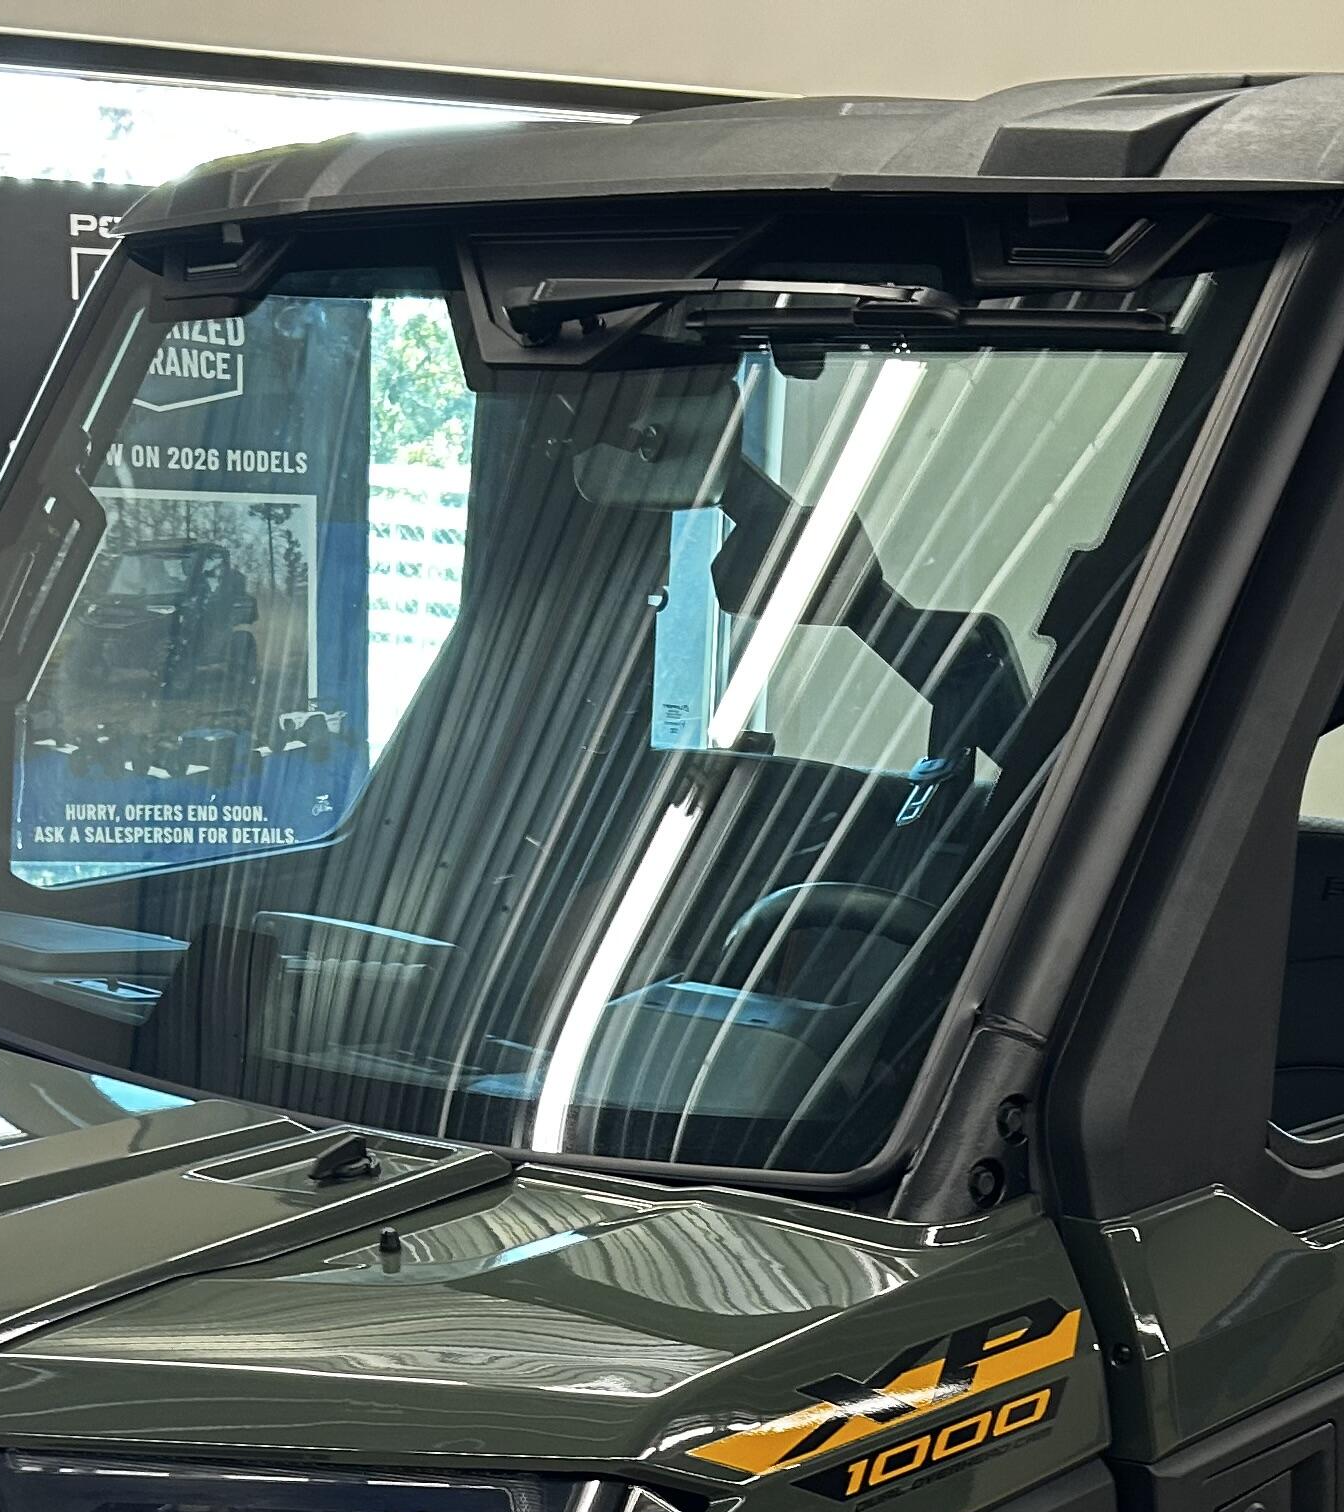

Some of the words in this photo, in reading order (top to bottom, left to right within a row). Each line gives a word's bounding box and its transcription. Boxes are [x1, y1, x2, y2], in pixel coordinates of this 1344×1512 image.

[131, 445, 160, 468] ON
[167, 447, 220, 470] 2026
[227, 449, 307, 474] MODELS
[65, 804, 120, 822] HURRY,
[125, 804, 183, 821] OFFERS
[187, 805, 218, 821] END
[222, 805, 268, 822] SOON.
[34, 826, 65, 843] ASK
[69, 826, 81, 843] A
[84, 827, 195, 844] SALESPERSON
[198, 827, 229, 844] FOR
[232, 828, 299, 845] DETAILS.
[780, 1297, 1068, 1464] XP
[844, 1388, 1052, 1497] 1000
